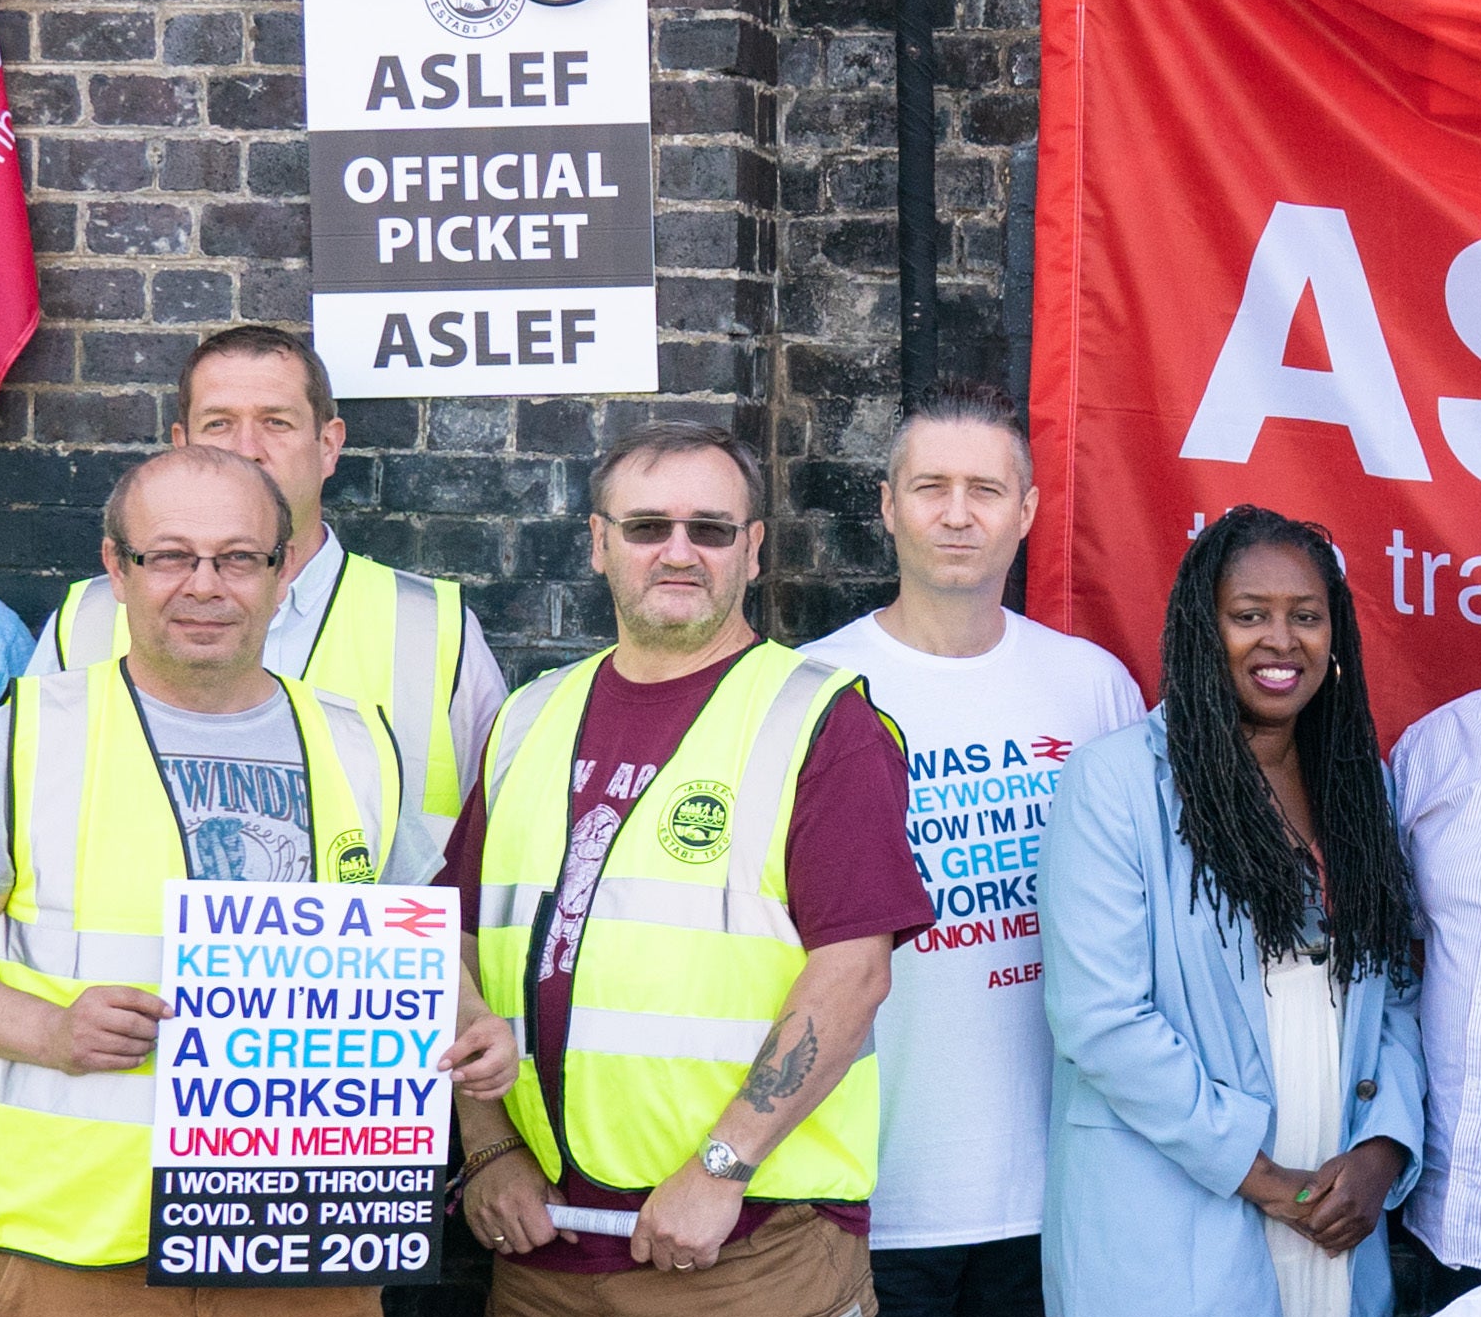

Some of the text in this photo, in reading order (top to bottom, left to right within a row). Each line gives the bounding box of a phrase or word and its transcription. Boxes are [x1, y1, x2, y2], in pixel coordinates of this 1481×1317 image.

[366, 51, 588, 111] ASLEF
[344, 152, 618, 203] OFFICIAL
[378, 214, 588, 264] PICKET
[373, 309, 596, 368] ASLEF
[1003, 740, 1027, 769] A
[977, 808, 1016, 842] I'M
[179, 895, 372, 936] I WAS A
[914, 920, 994, 953] UNION
[177, 945, 445, 979] KEYWORKER
[988, 962, 1043, 989] ASLEF
[174, 987, 443, 1020] NOW I'M JUST
[173, 1028, 440, 1068] A GREEDY
[173, 1078, 438, 1117] WORKSHY
[169, 1127, 434, 1156] UNION MEMBER
[165, 1170, 433, 1193] I WORKED THROUGH
[164, 1201, 432, 1225] COVID. NO PAYRISE
[161, 1233, 430, 1273] SINCE 2019
